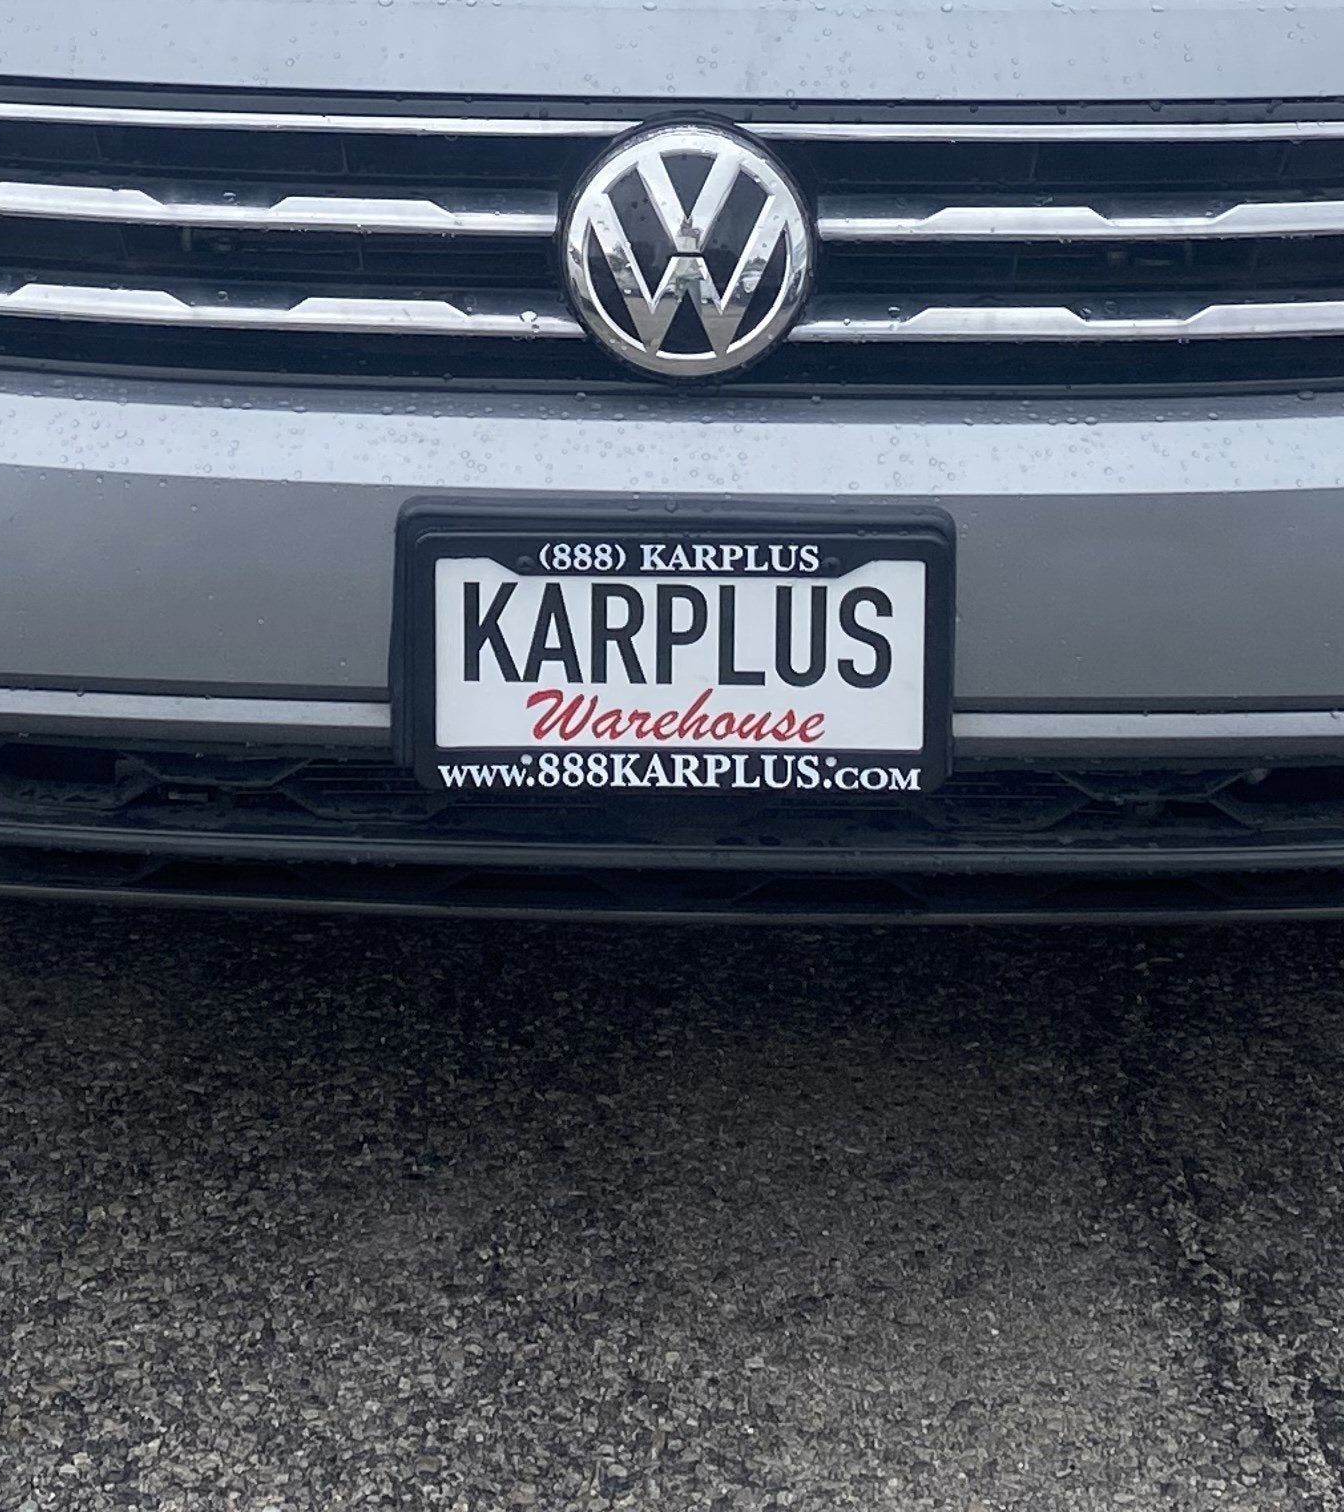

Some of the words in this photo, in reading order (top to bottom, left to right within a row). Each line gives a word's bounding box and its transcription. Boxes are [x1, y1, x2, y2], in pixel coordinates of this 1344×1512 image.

[538, 543, 626, 571] (888)
[640, 543, 820, 573] KARPLUS
[463, 581, 894, 689] KARPLUS
[525, 688, 826, 743] Warehouse
